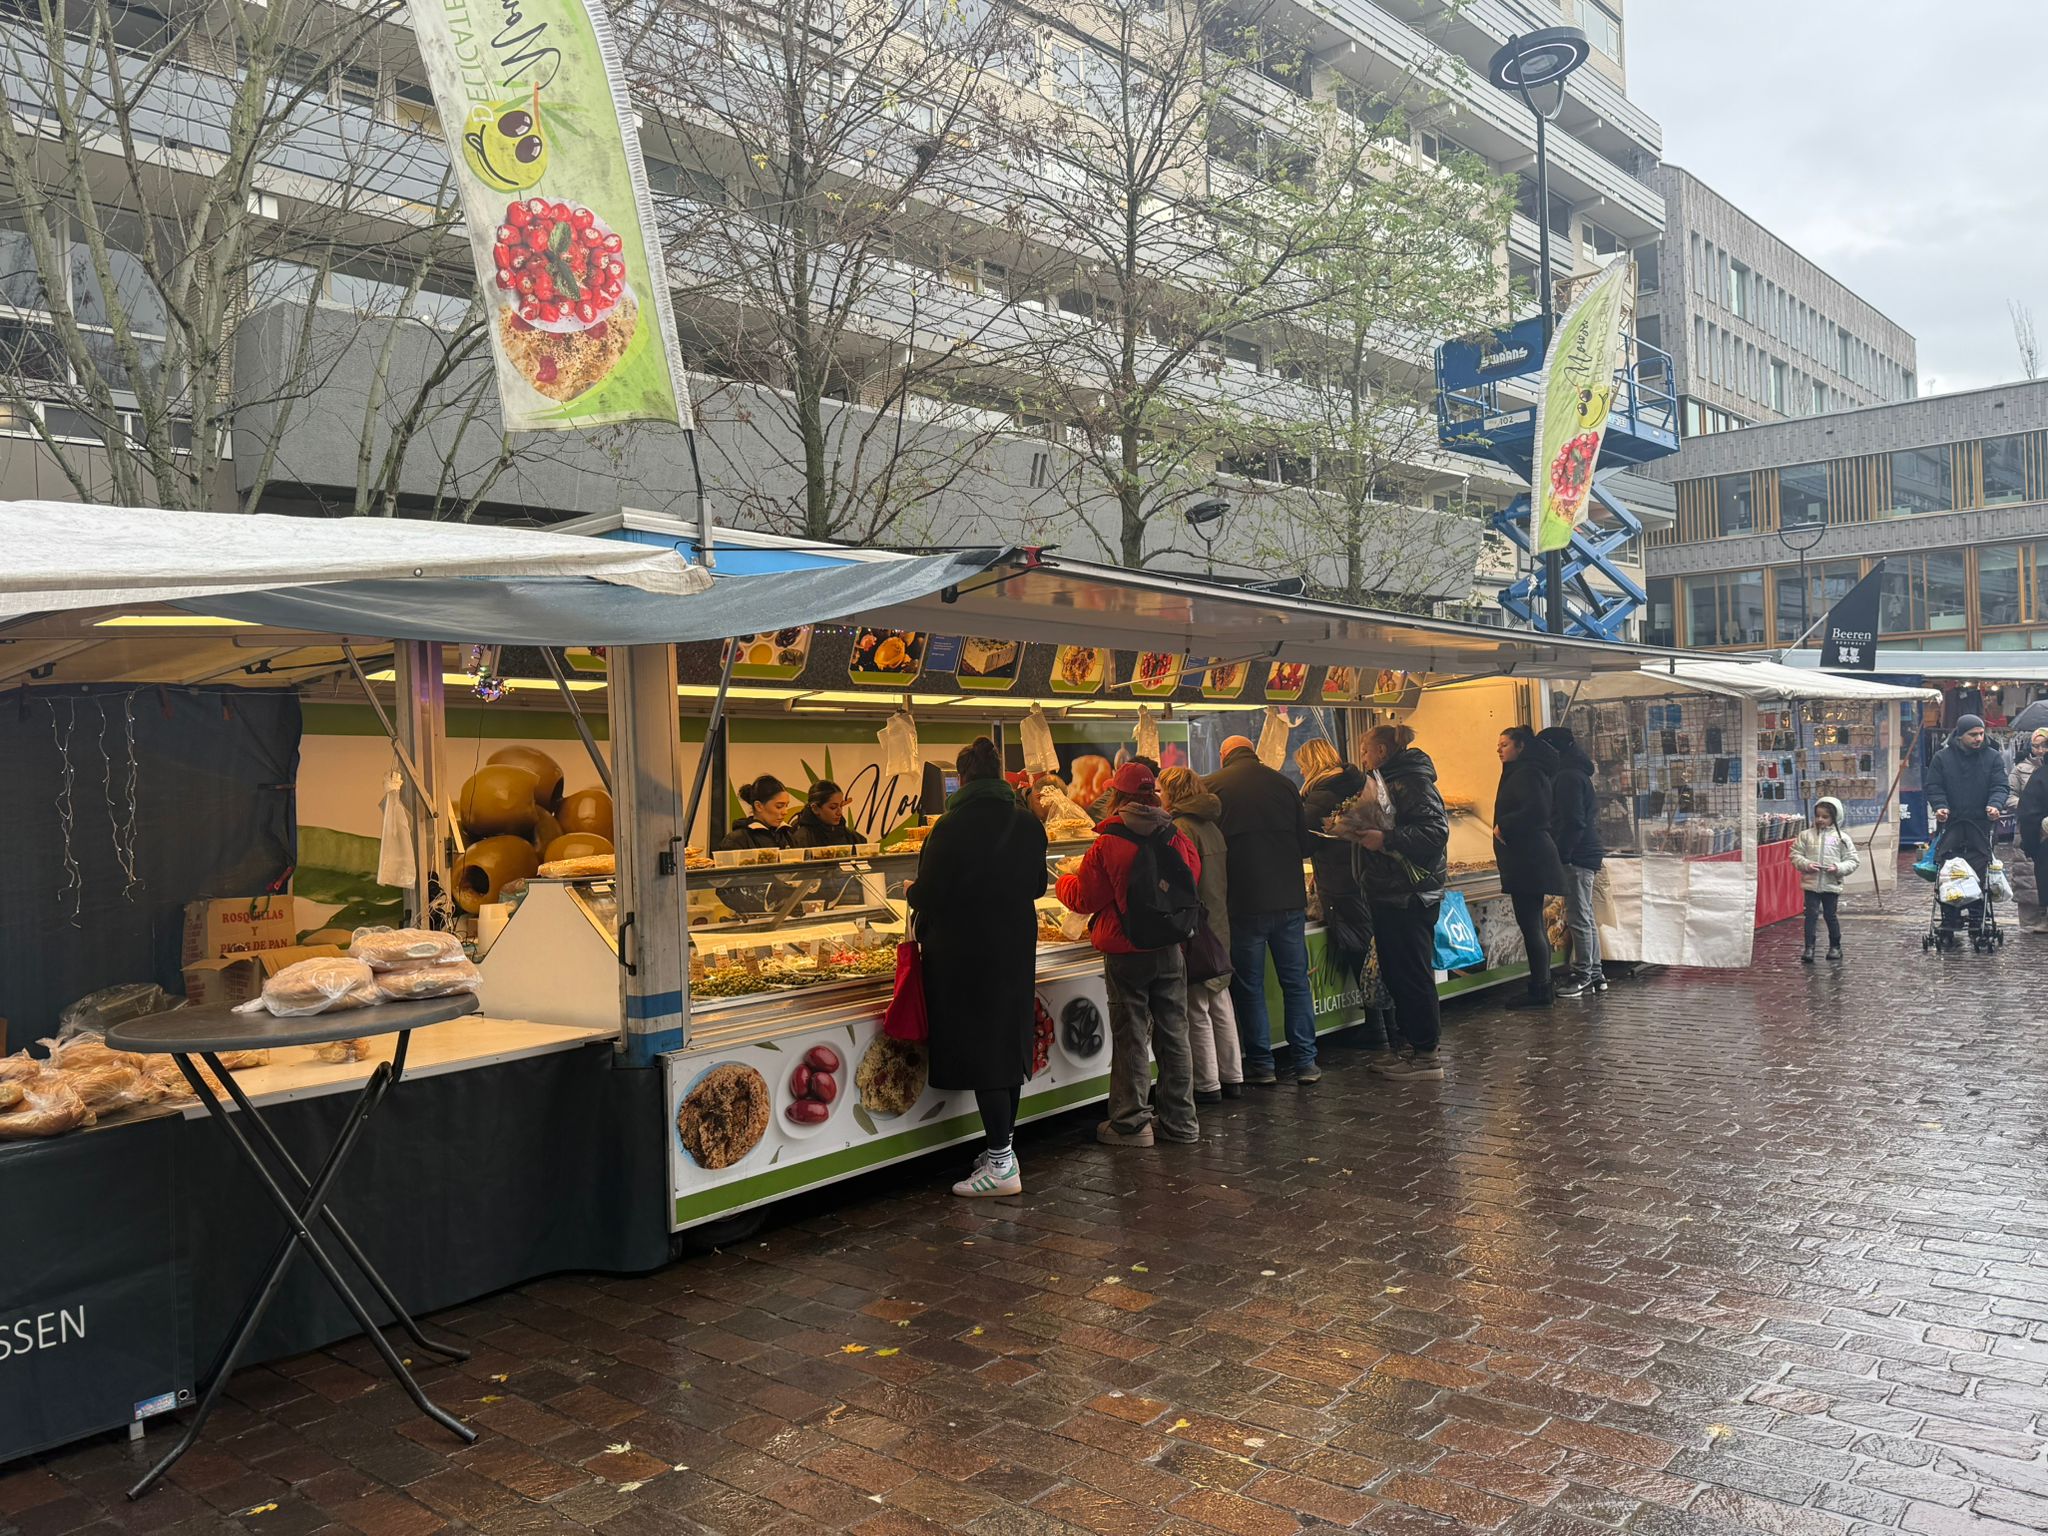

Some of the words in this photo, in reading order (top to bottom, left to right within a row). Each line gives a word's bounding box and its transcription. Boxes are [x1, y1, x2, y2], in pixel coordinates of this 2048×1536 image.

[1832, 627, 1872, 640] Beeren
[251, 926, 259, 937] Y
[253, 940, 267, 951] DE
[268, 938, 288, 950] PAN
[1313, 989, 1364, 1015] ELICATESSE
[0, 1304, 85, 1360] SSEN
